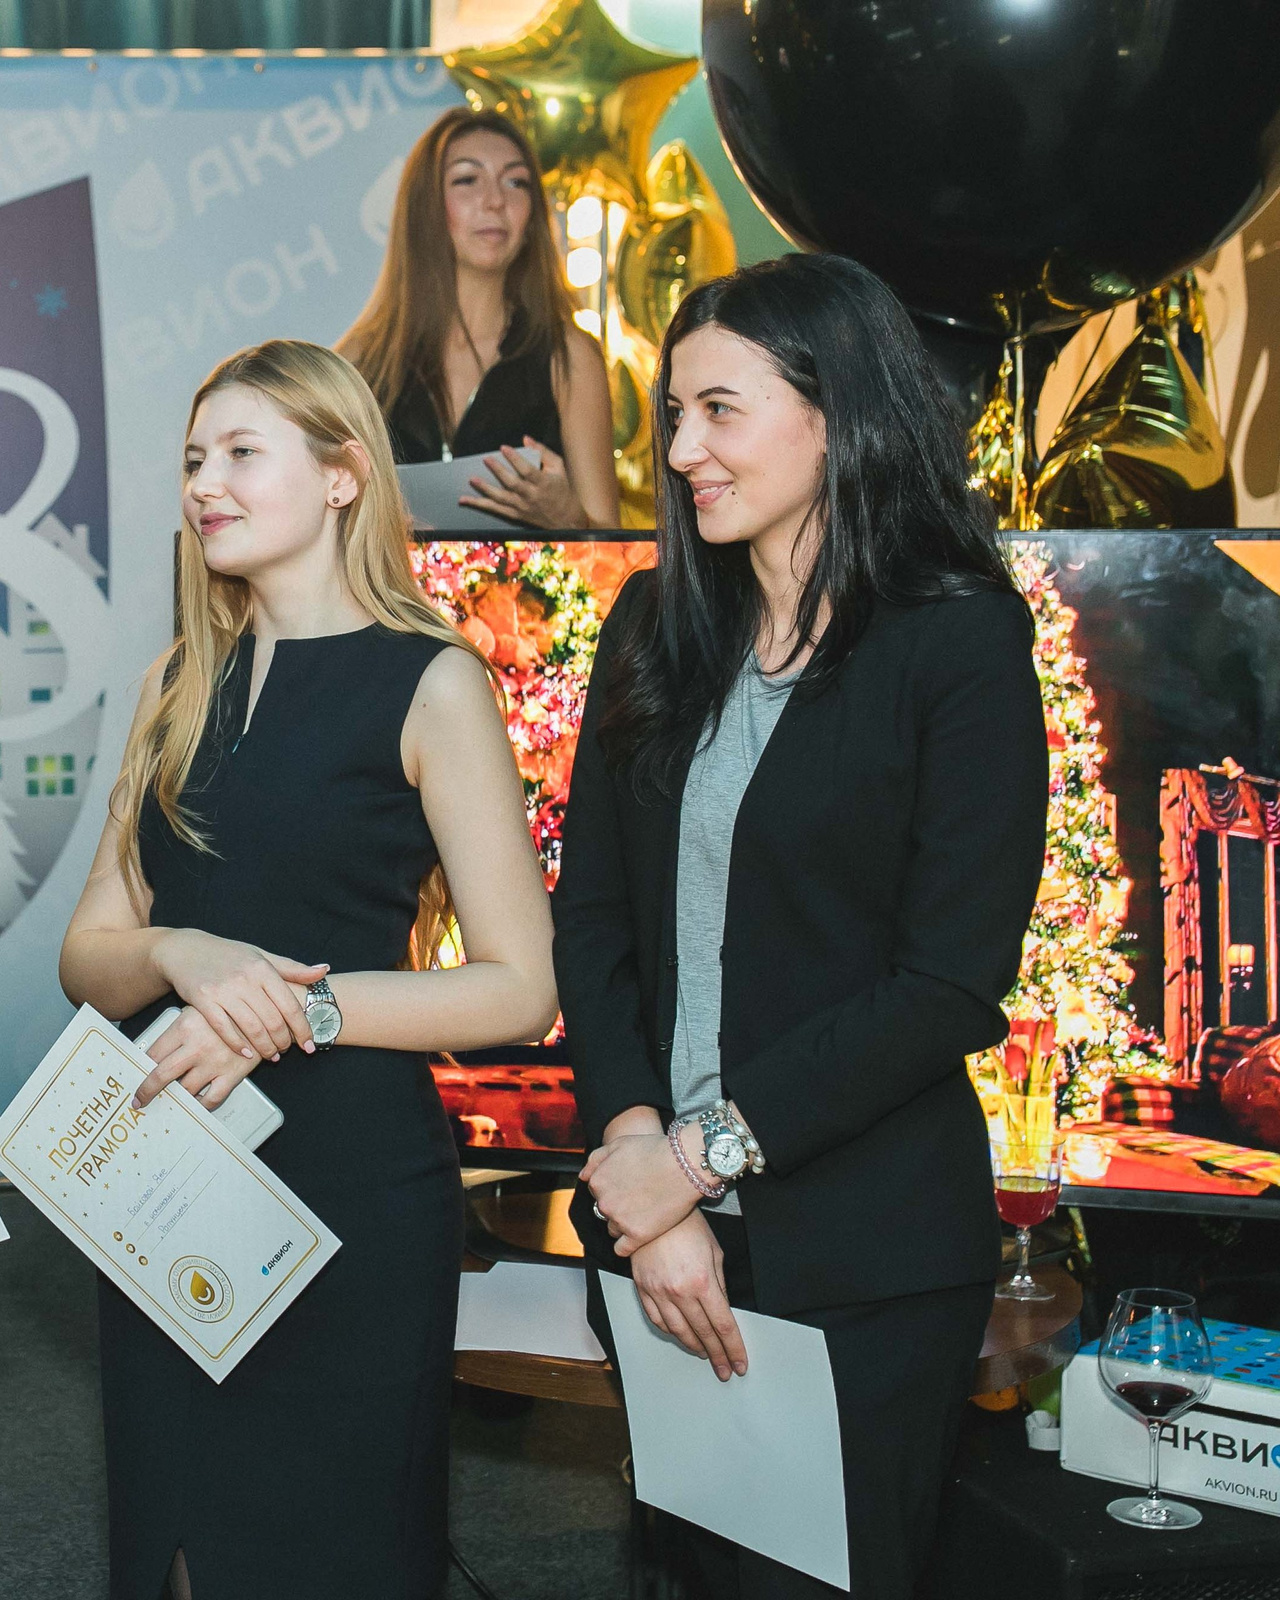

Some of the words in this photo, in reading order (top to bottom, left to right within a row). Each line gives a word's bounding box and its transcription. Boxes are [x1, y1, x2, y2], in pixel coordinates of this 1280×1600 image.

[188, 60, 448, 217] АКВИО
[122, 222, 344, 372] ВИОН
[48, 1075, 124, 1169] ПОЧЕТНАЯ
[75, 1106, 146, 1187] ГРАМОТА
[267, 1239, 293, 1271] АКВИОН
[1204, 1477, 1278, 1502] AKVION.RU
